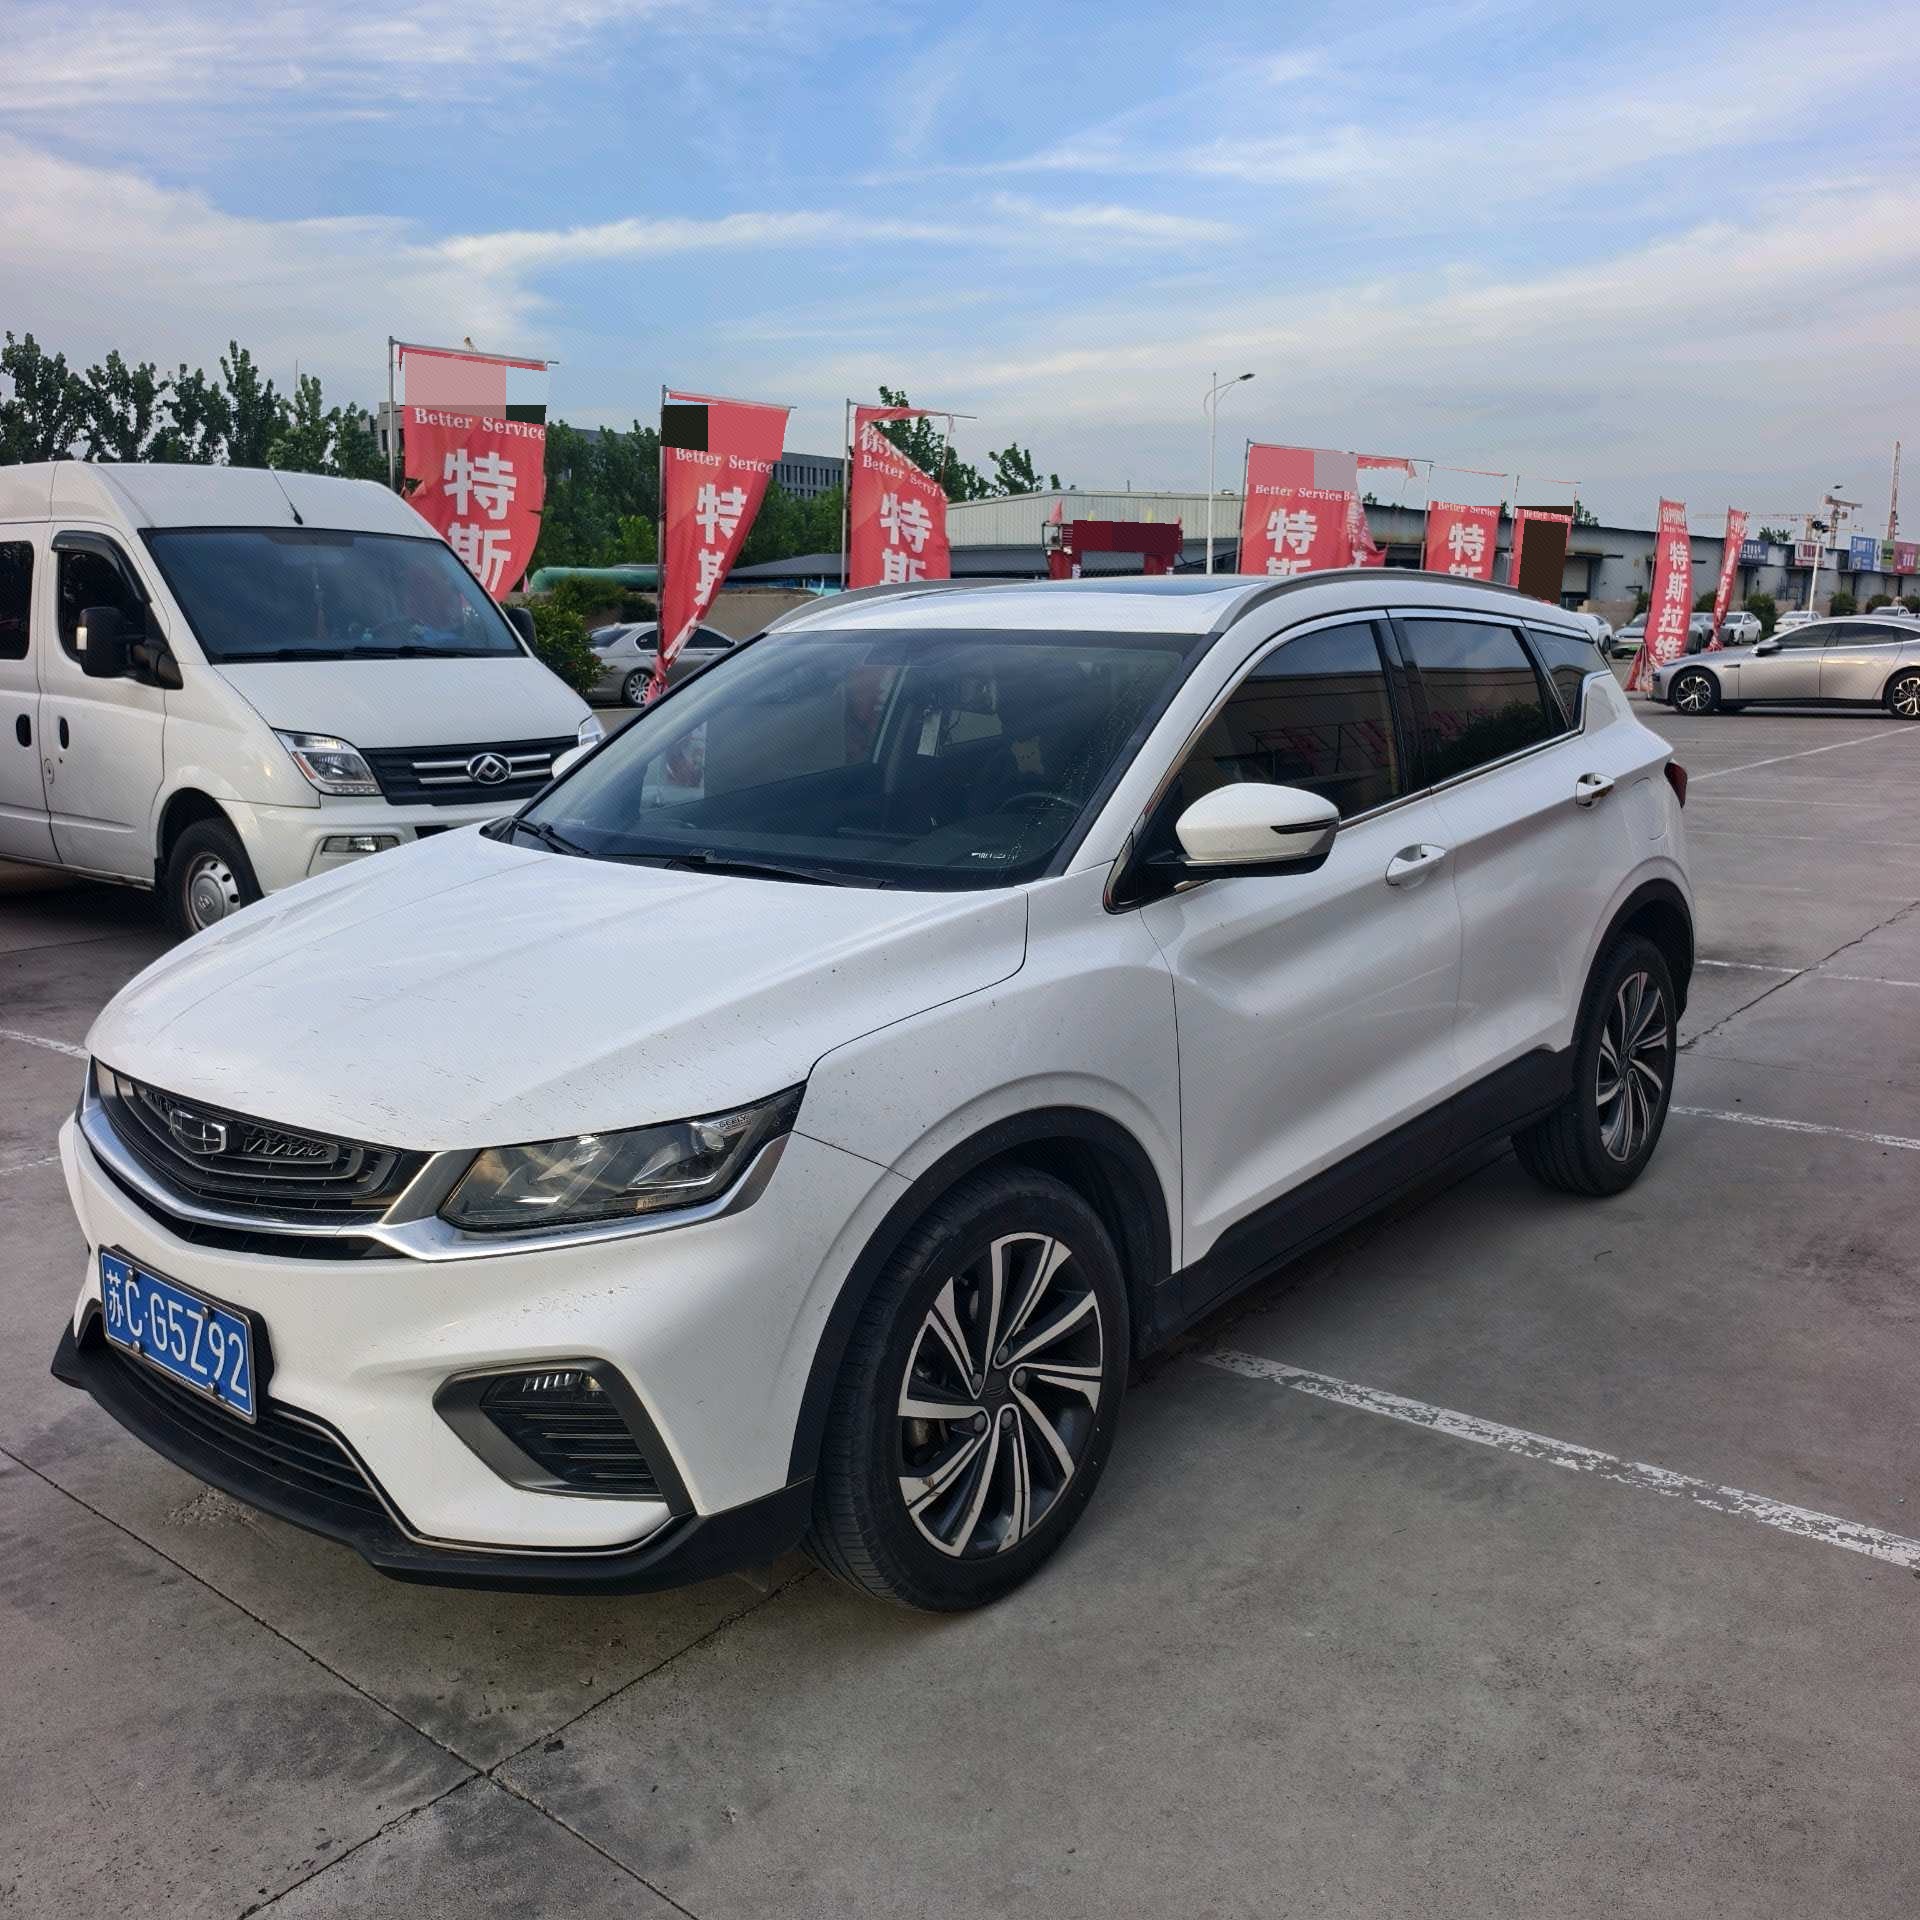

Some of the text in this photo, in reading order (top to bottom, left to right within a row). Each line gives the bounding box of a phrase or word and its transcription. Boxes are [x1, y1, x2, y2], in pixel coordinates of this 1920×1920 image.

[414, 408, 546, 440] Better Service
[676, 448, 721, 467] Better
[862, 455, 905, 480] Better
[1255, 485, 1293, 497] Better
[1298, 487, 1342, 501] Service
[443, 448, 517, 592] 特斯
